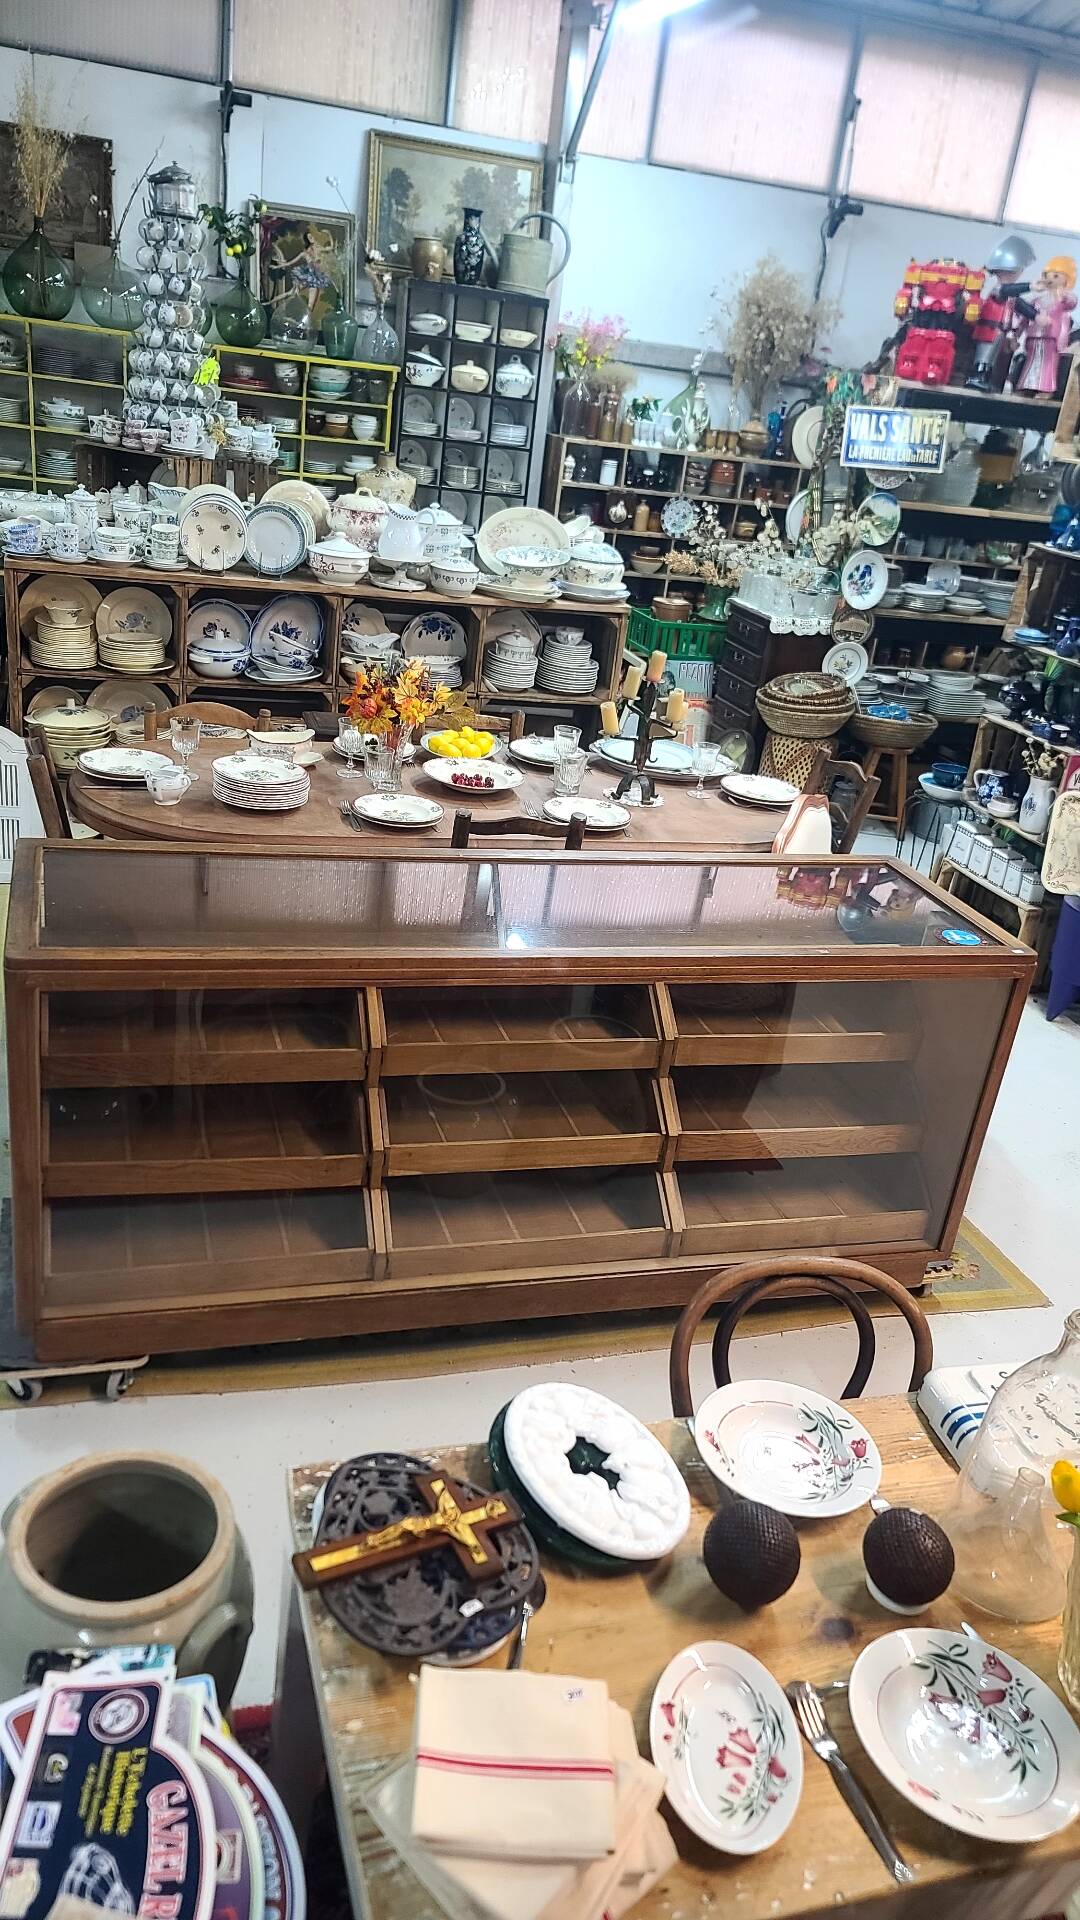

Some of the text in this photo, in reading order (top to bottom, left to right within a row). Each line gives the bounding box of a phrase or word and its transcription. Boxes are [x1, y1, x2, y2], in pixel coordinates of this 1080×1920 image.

[850, 413, 888, 441] VALS
[848, 444, 858, 459] LA
[917, 448, 938, 464] TABLE
